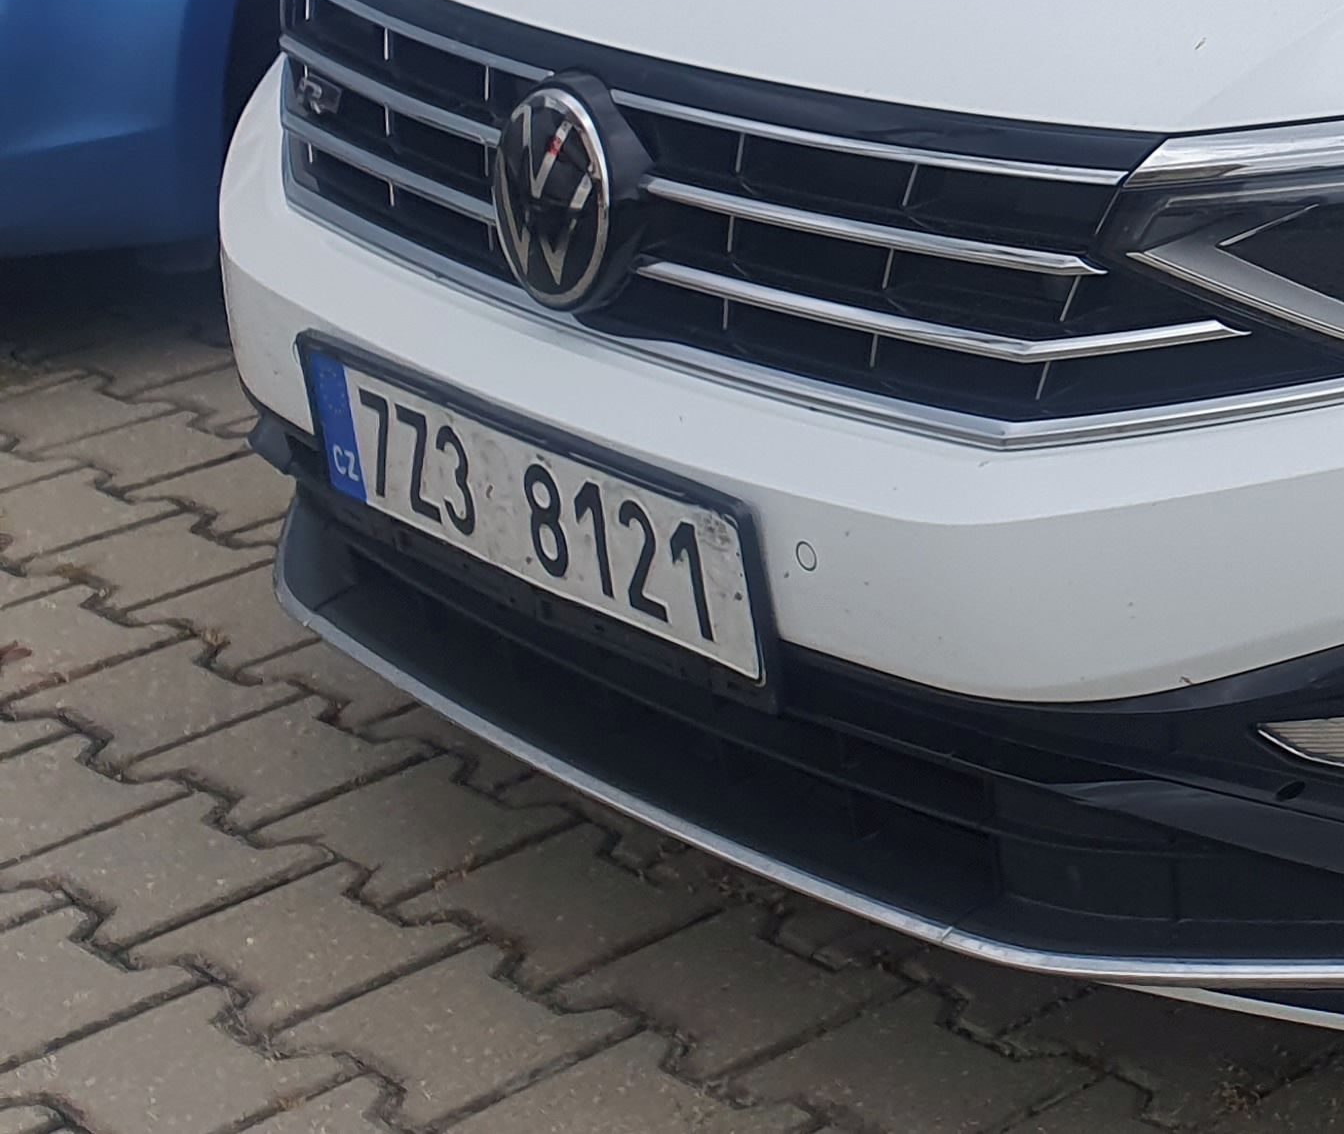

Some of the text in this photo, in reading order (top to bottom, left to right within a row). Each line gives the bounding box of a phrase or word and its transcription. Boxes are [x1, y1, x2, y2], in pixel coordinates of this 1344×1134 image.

[333, 444, 360, 482] CZ
[358, 386, 716, 643] 7Z3 8121
